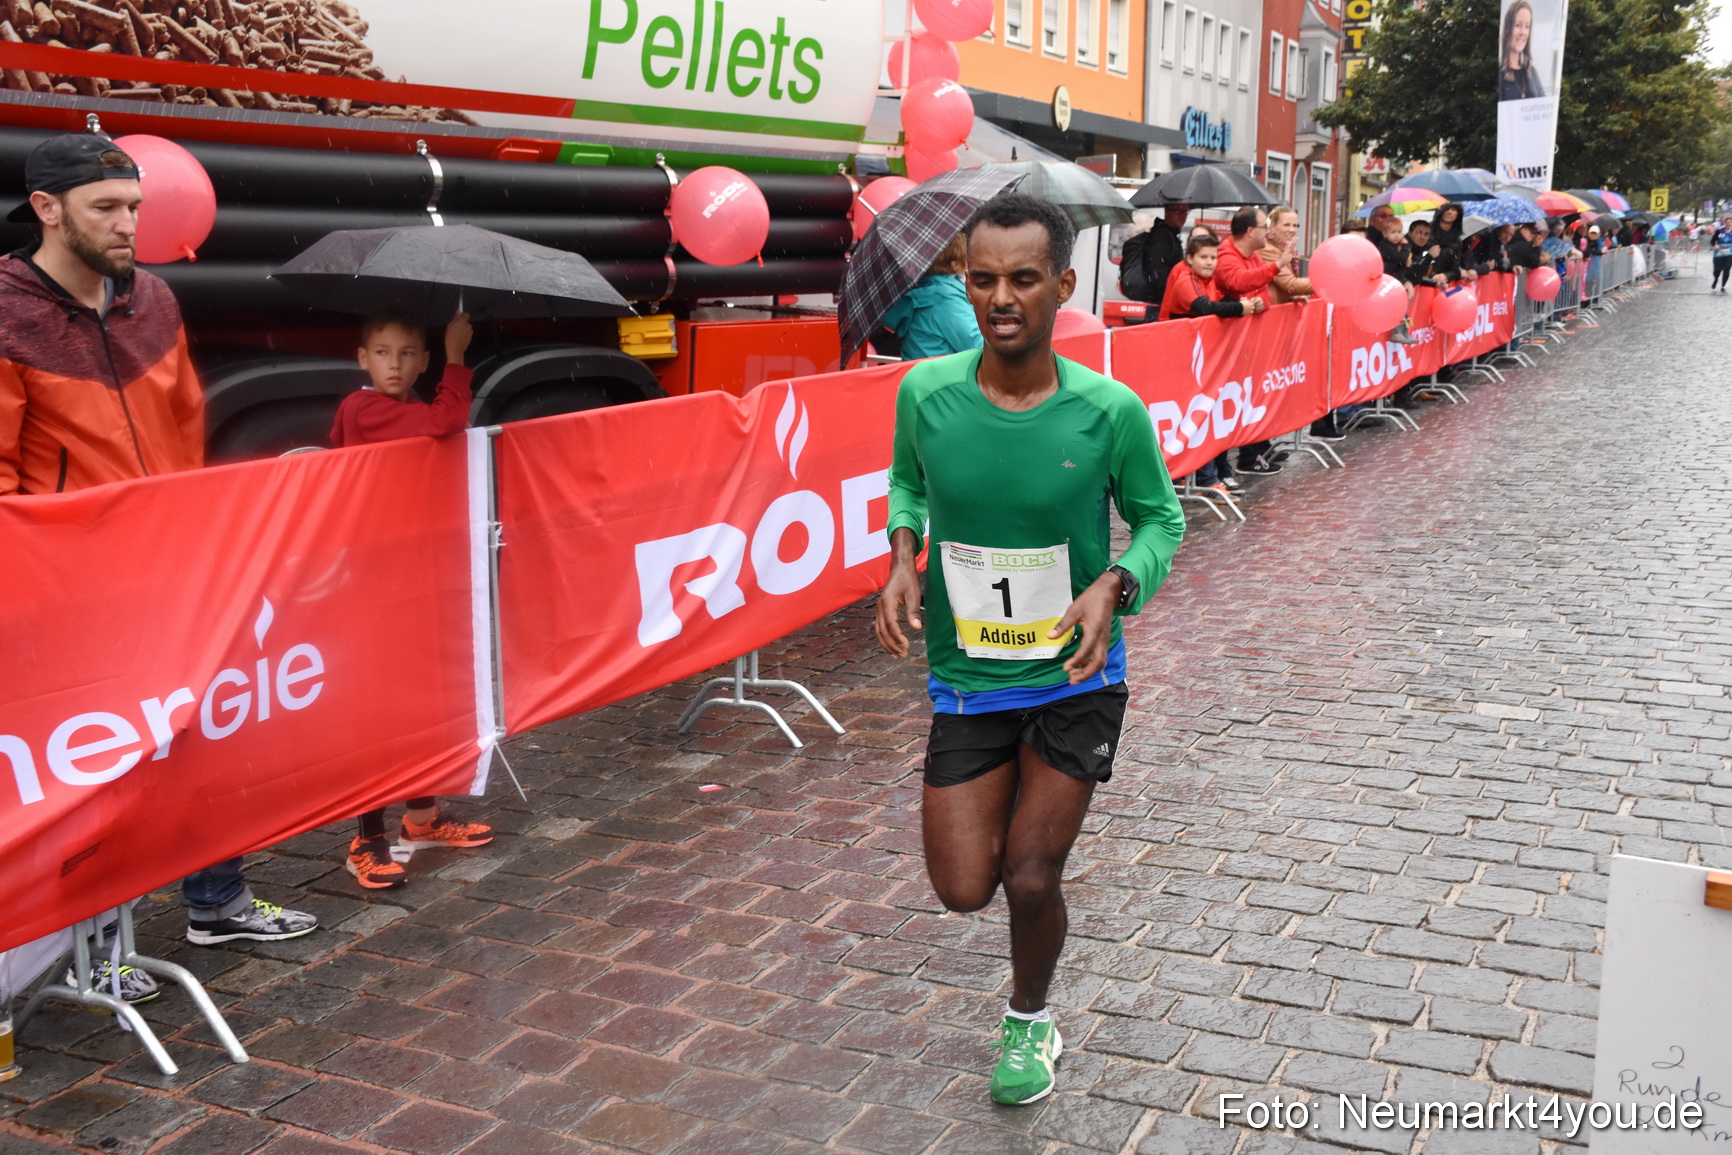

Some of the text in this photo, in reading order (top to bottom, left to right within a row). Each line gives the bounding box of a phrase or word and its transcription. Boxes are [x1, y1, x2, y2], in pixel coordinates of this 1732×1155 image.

[581, 0, 823, 104] Pellets
[1345, 0, 1372, 98] OTE
[991, 550, 1057, 568] BOCK
[991, 577, 1012, 618] 1
[980, 626, 1036, 645] Addisu
[1651, 1045, 1685, 1069] 2
[1618, 1069, 1732, 1108] Runde
